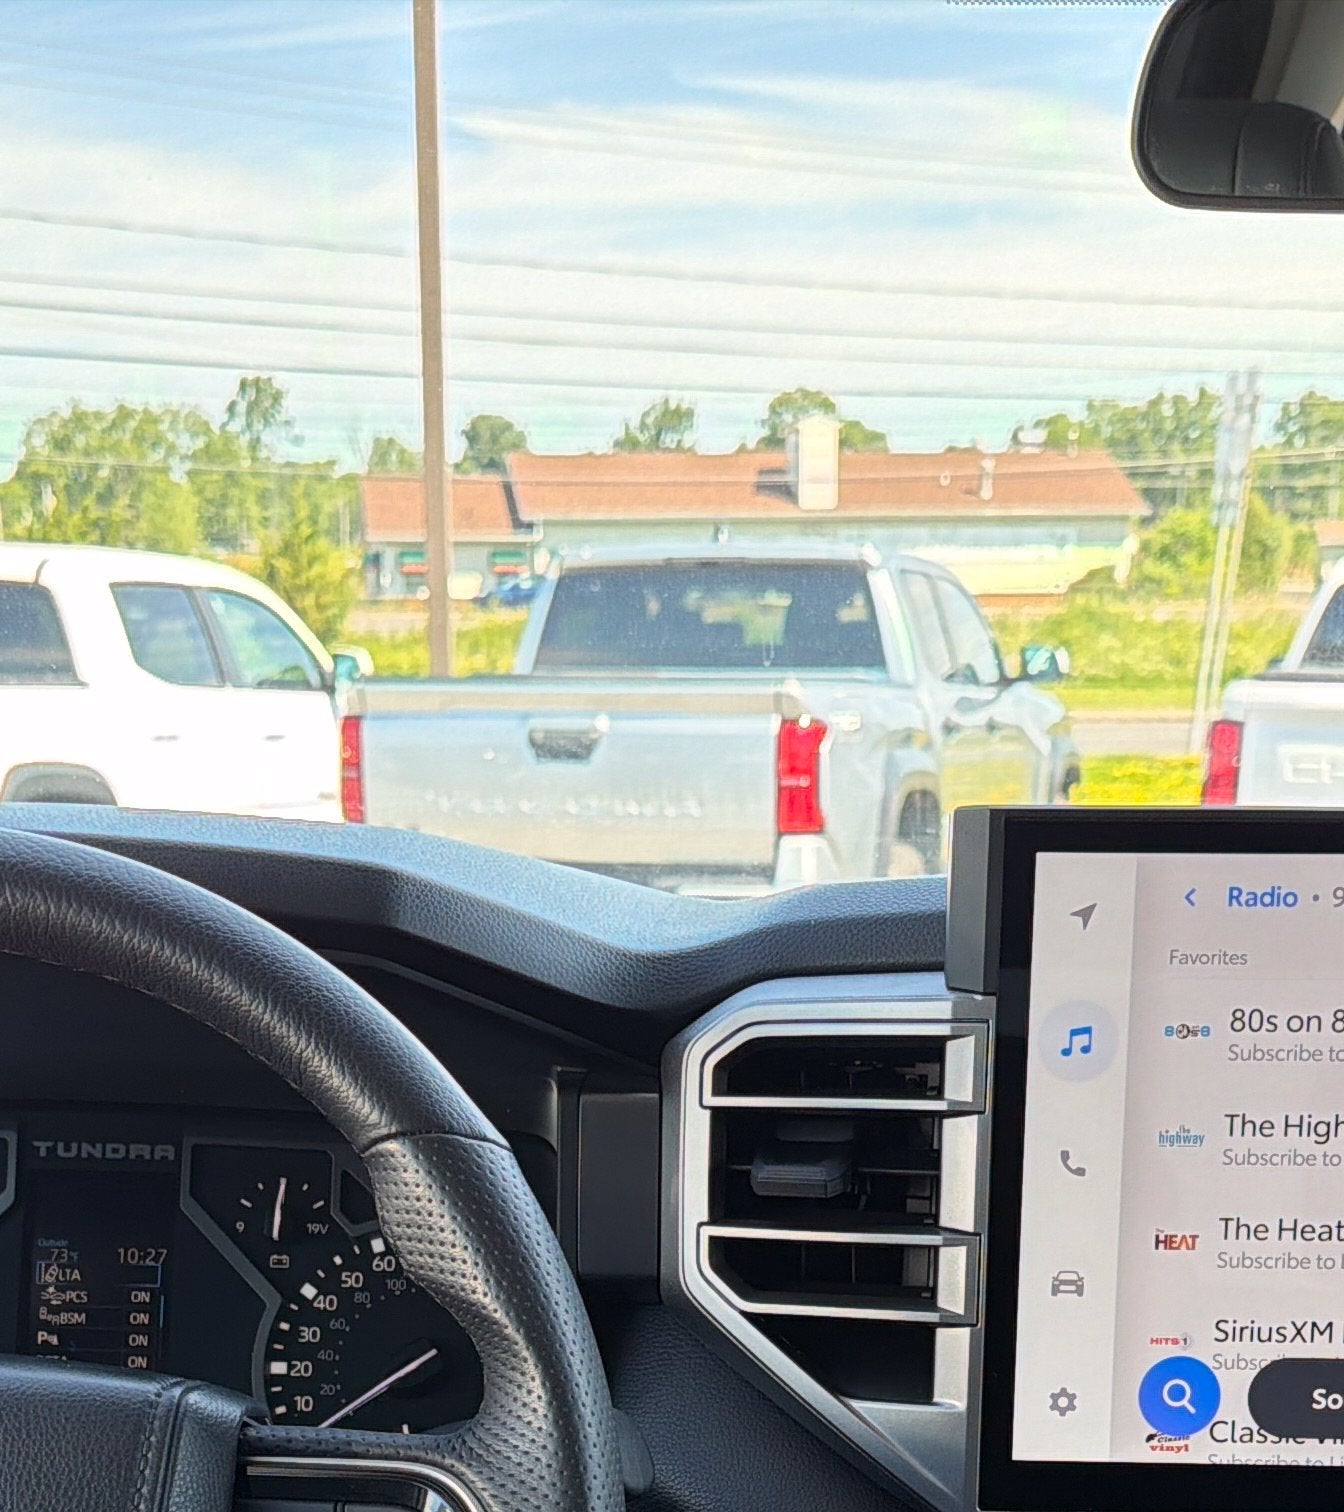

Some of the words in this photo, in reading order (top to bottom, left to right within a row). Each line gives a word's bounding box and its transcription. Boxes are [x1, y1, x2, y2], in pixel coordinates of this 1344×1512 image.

[1227, 886, 1298, 907] Radio
[1169, 949, 1248, 966] Favorites
[1230, 1009, 1278, 1033] 80s
[1287, 1014, 1322, 1033] on
[1228, 1044, 1323, 1062] Subscribe
[1224, 1113, 1275, 1137] The
[1158, 1130, 1205, 1147] highway
[33, 1140, 175, 1160] TUNDRA
[1222, 1149, 1317, 1166] Subscribe
[1322, 1151, 1342, 1167] to
[236, 1222, 245, 1232] 9
[307, 1223, 329, 1234] 19V
[1219, 1217, 1269, 1241] The
[1155, 1234, 1199, 1250] HEAT
[118, 1248, 167, 1264] 10:27
[372, 1256, 395, 1271] 60
[1217, 1252, 1312, 1270] Subscribe
[1317, 1254, 1337, 1270] to
[58, 1269, 81, 1281] LTA
[341, 1272, 363, 1288] 50
[386, 1279, 406, 1290] 100
[66, 1291, 88, 1302] PCS
[131, 1291, 151, 1302] ON
[313, 1295, 338, 1311] 40
[354, 1292, 370, 1304] 80
[60, 1313, 86, 1325] BSM
[130, 1313, 149, 1324] ON
[329, 1318, 345, 1329] 60
[298, 1326, 321, 1343] 30
[1214, 1319, 1333, 1343] SiriusXM
[129, 1334, 148, 1346] ON
[1150, 1337, 1180, 1345] HITS
[128, 1356, 147, 1368] ON
[317, 1350, 333, 1361] 40
[1212, 1353, 1283, 1370] Subsc
[290, 1361, 312, 1377] 20
[320, 1384, 335, 1395] 20
[294, 1396, 313, 1412] 10
[1209, 1420, 1305, 1444] Clas
[1149, 1444, 1189, 1453] vinyl
